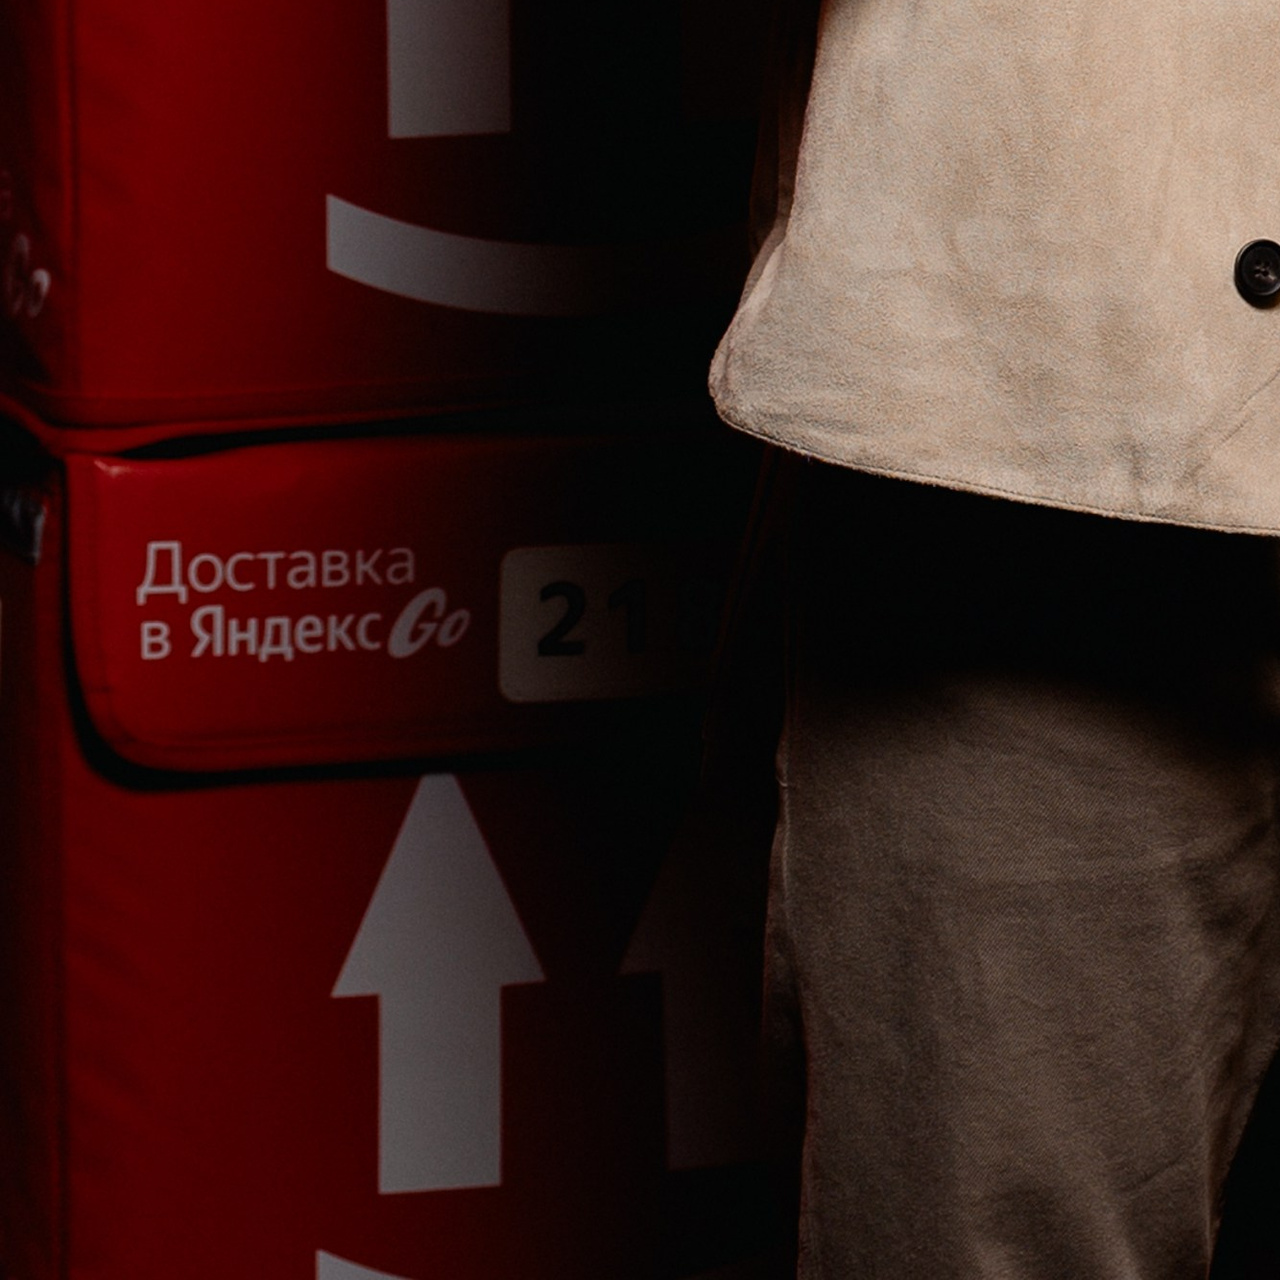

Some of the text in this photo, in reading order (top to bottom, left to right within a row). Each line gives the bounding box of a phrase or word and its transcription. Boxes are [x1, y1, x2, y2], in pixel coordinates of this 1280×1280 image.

[135, 539, 416, 607] Доставка
[139, 586, 472, 664] в Яндекс Go
